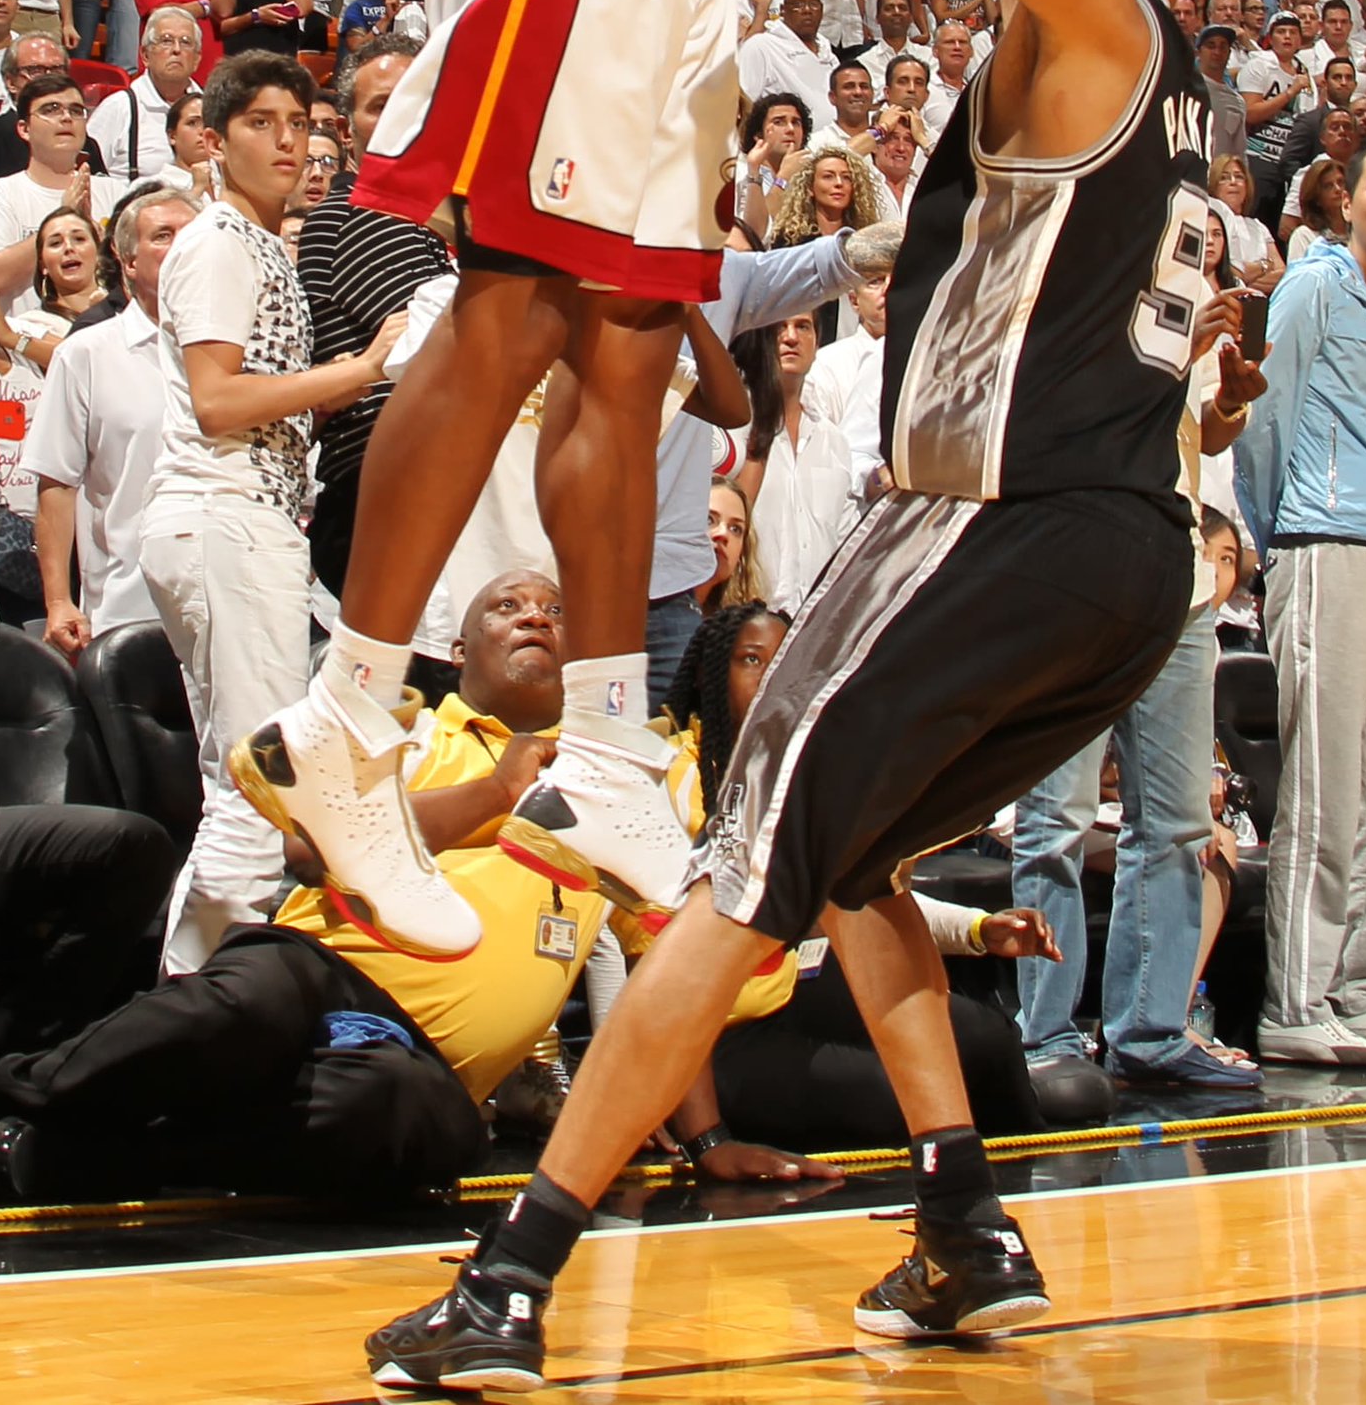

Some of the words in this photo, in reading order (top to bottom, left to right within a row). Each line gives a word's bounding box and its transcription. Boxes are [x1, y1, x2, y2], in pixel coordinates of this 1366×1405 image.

[362, 5, 387, 17] EXPR
[1127, 179, 1211, 382] 9
[1000, 1230, 1025, 1255] 9
[507, 1291, 534, 1320] 9
